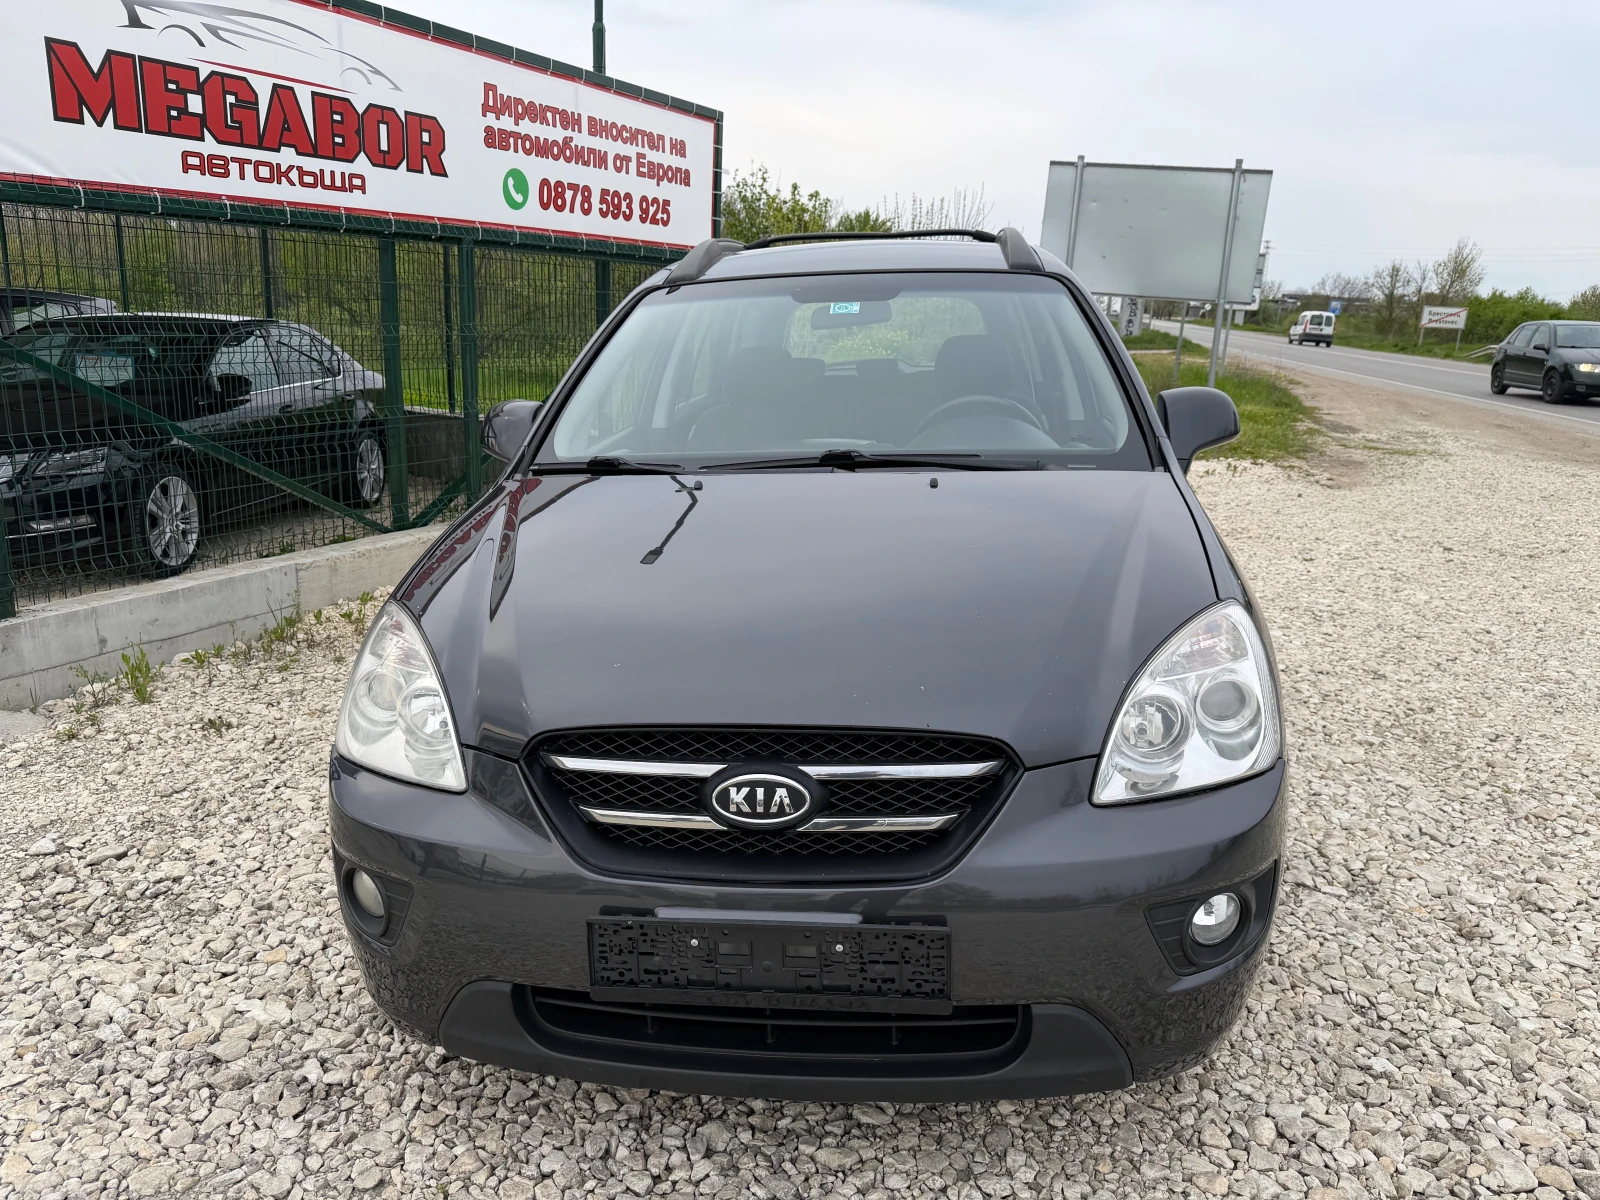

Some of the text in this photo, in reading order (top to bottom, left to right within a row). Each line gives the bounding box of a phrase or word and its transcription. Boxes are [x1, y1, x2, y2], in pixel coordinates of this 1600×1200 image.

[44, 36, 449, 178] MEGABOR
[481, 82, 687, 158] Директен вносител на
[181, 151, 367, 194] АВТОКЪЩА
[483, 125, 691, 187] автомобили от Европа
[538, 178, 671, 227] 0878 593 925
[728, 787, 794, 813] KIA
